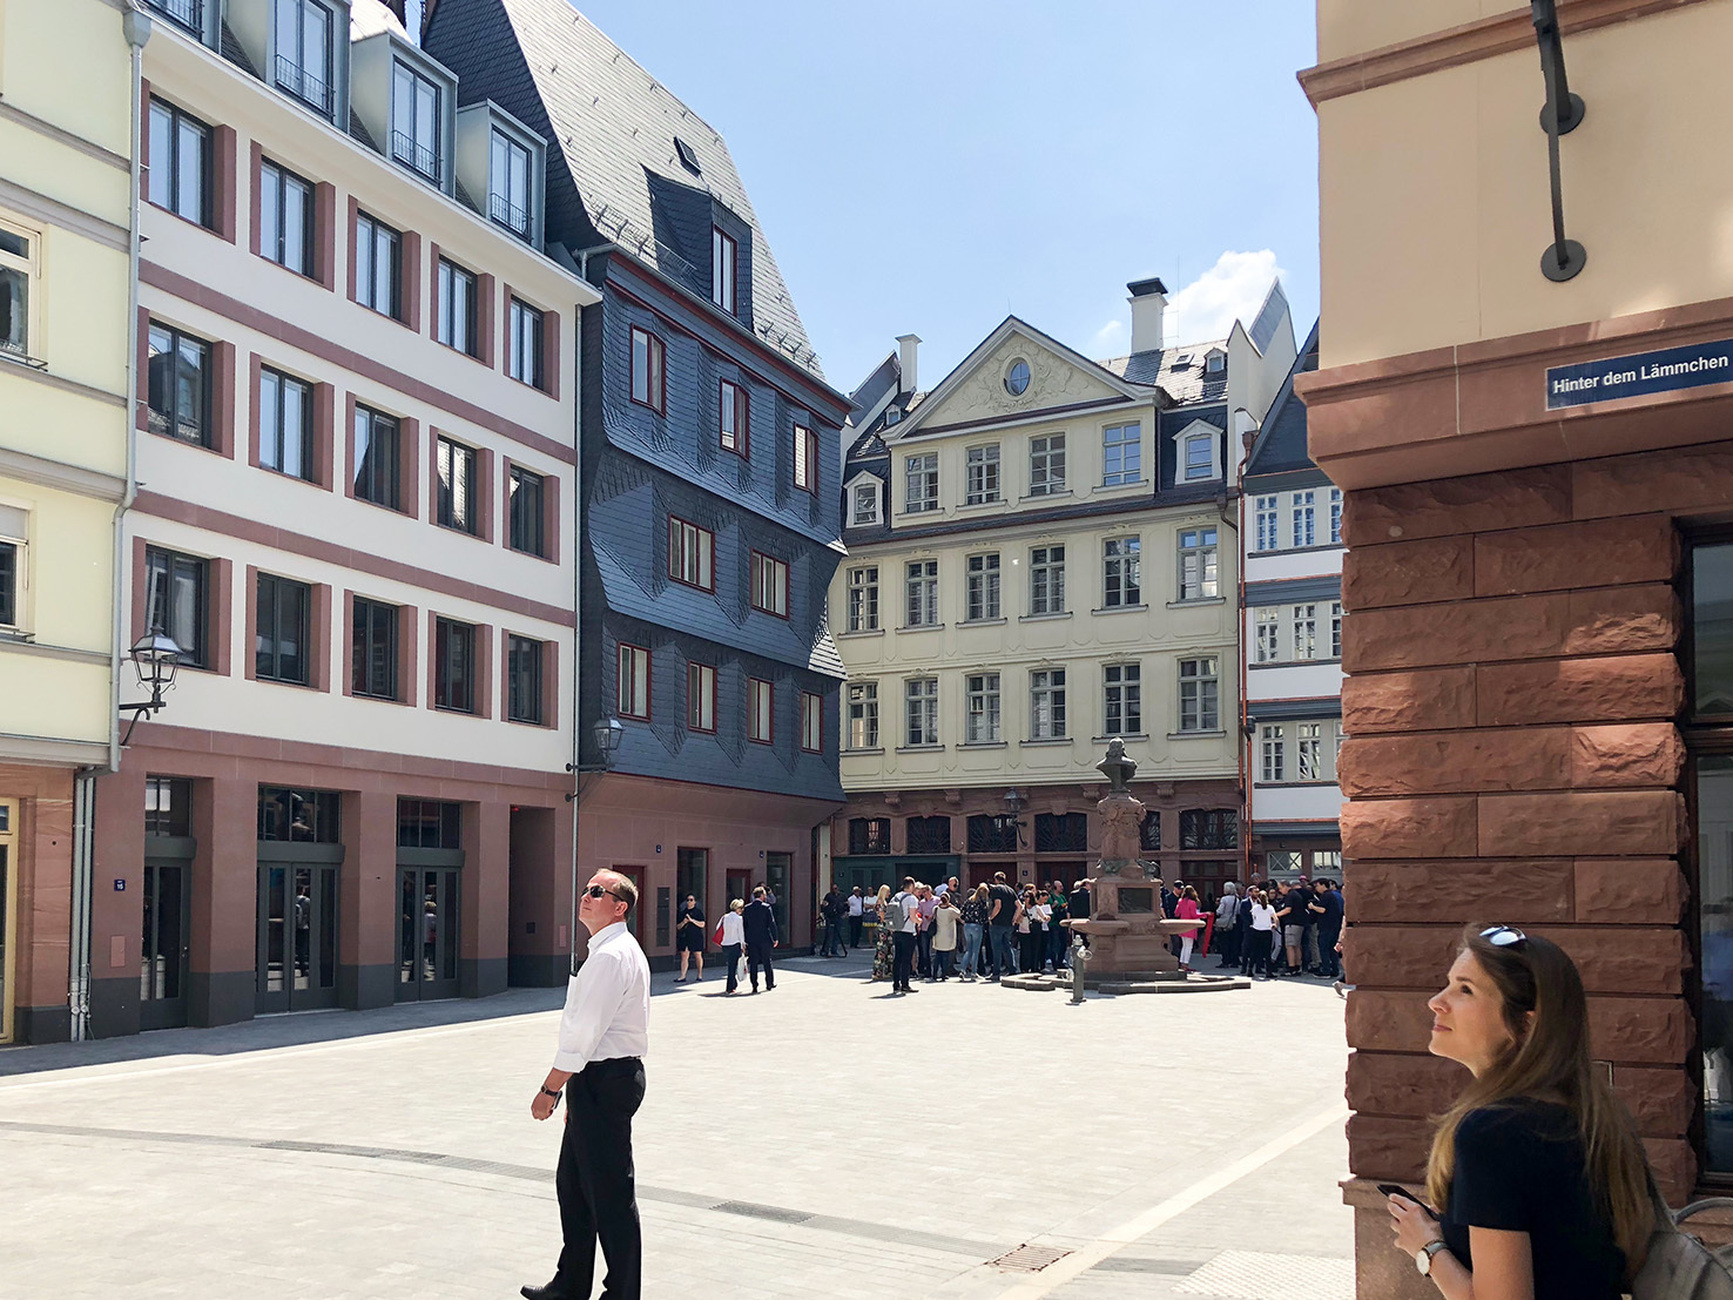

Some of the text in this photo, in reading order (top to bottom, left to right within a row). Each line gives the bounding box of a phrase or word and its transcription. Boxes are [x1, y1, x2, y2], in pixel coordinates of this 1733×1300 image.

[1553, 356, 1729, 394] Hinter dem Lämmchen
